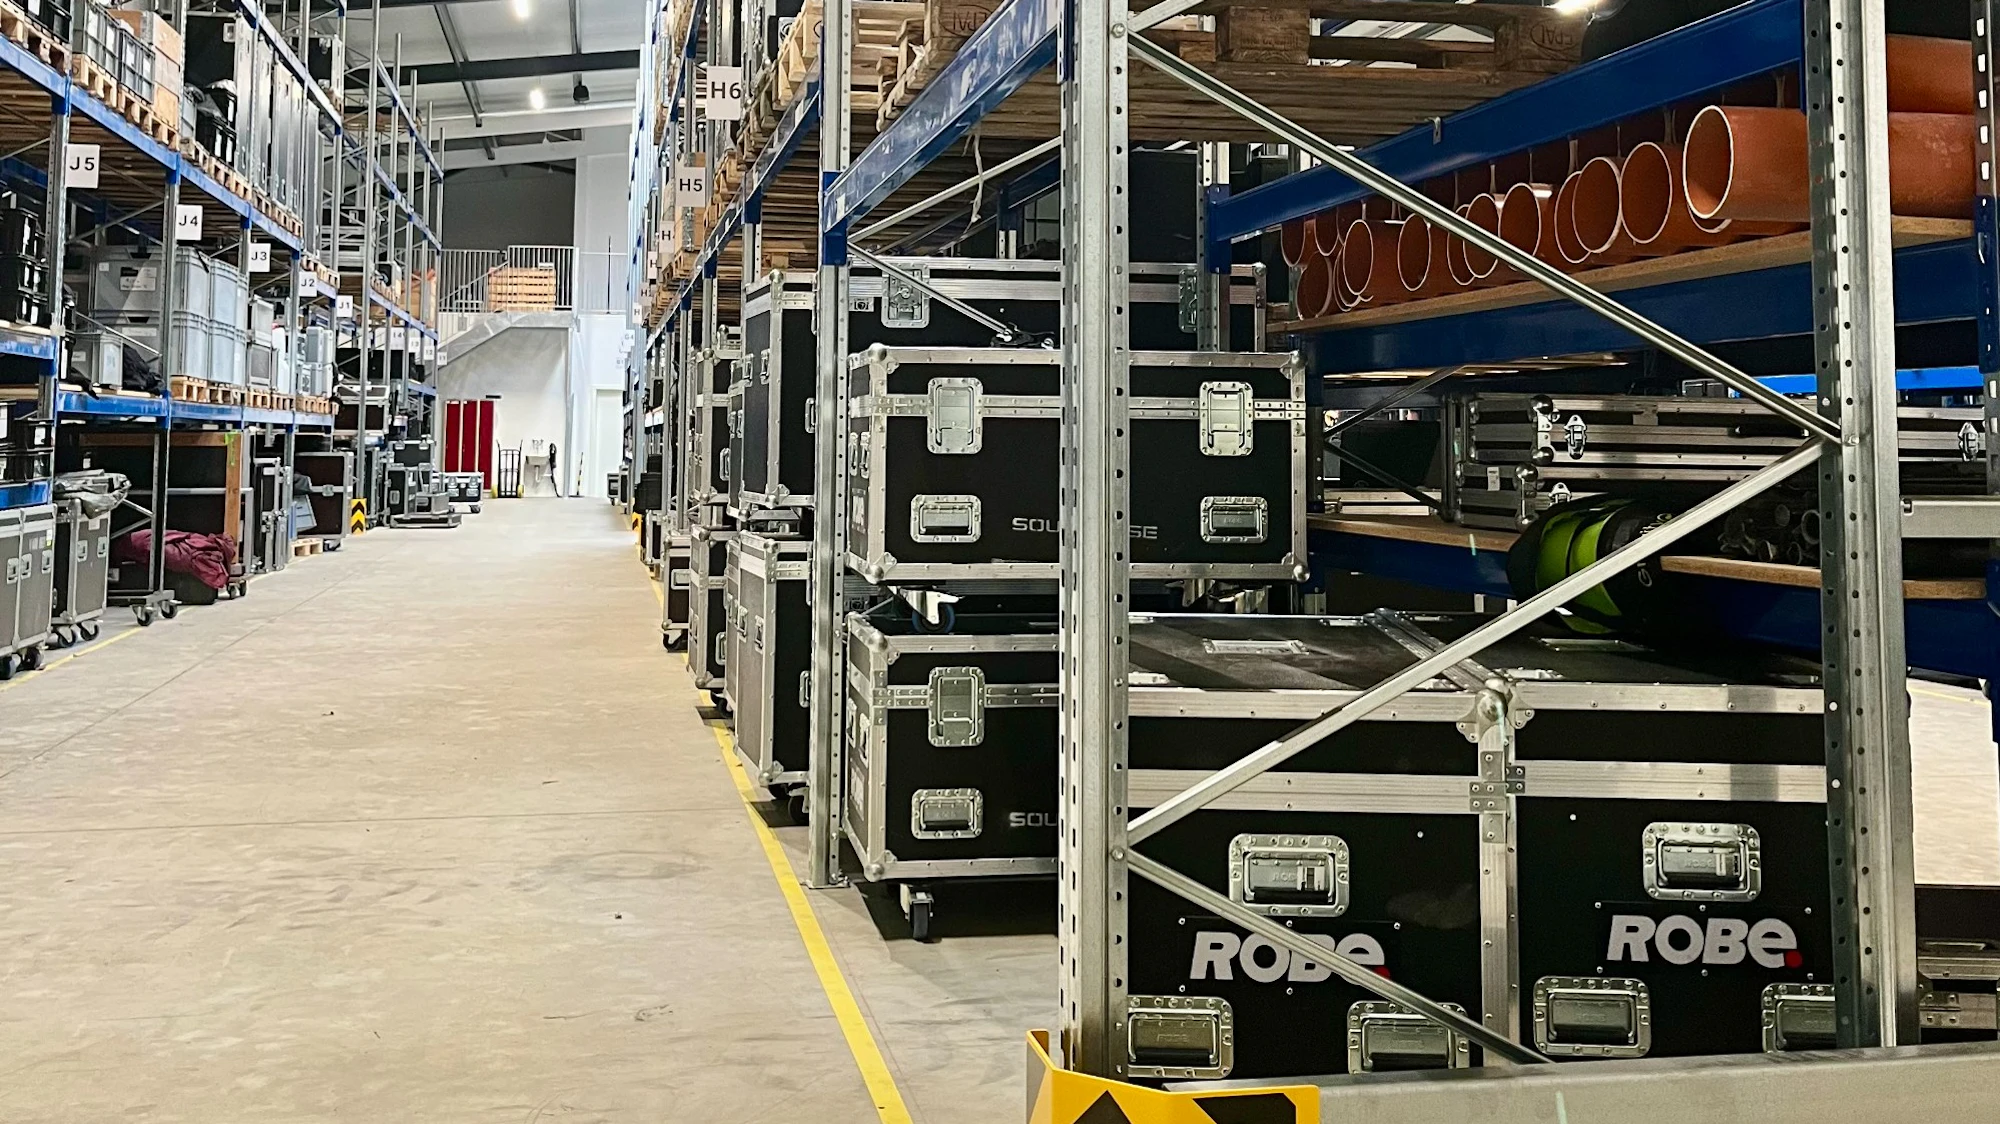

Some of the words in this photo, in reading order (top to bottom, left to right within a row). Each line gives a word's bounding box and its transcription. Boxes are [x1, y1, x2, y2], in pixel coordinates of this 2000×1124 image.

[711, 81, 741, 99] H6
[69, 157, 95, 171] J5
[679, 178, 703, 192] H5
[178, 214, 199, 227] J4
[251, 251, 267, 261] J3
[300, 278, 315, 287] J2
[338, 301, 350, 309] J1
